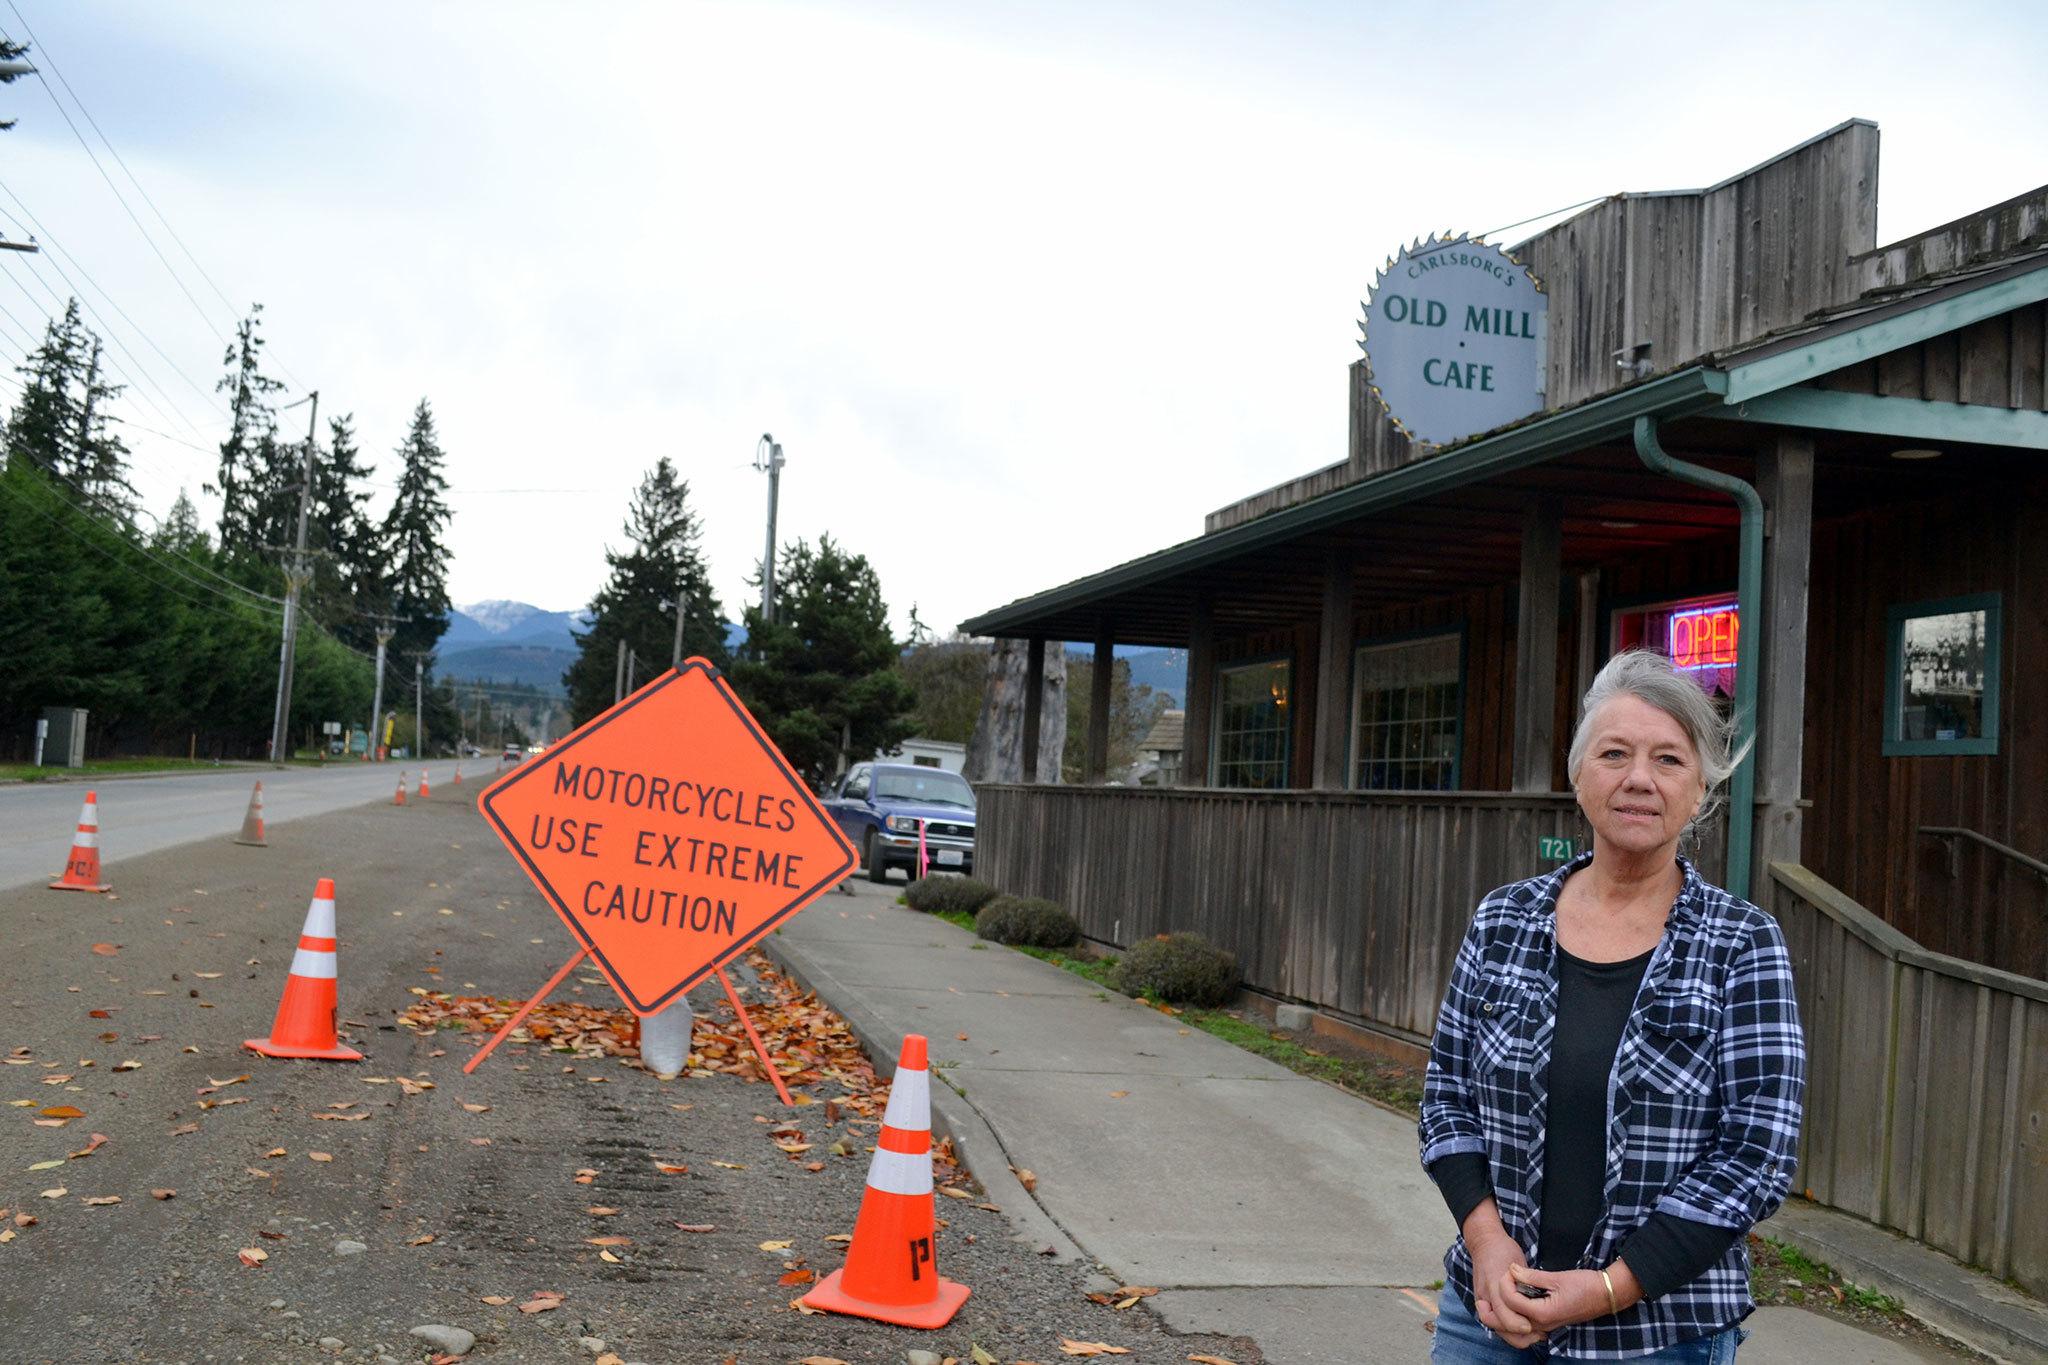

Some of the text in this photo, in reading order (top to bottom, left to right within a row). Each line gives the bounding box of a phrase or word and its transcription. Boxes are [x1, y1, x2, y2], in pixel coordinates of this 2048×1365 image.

[1408, 252, 1515, 287] CARLSBORG'S
[1383, 295, 1535, 340] OLD MILL
[1423, 358, 1495, 393] CAFE
[553, 761, 796, 832] MOTORCYCLES
[530, 814, 803, 889] USE EXTREME
[1542, 838, 1573, 860] 721
[583, 881, 738, 936] CAUTION
